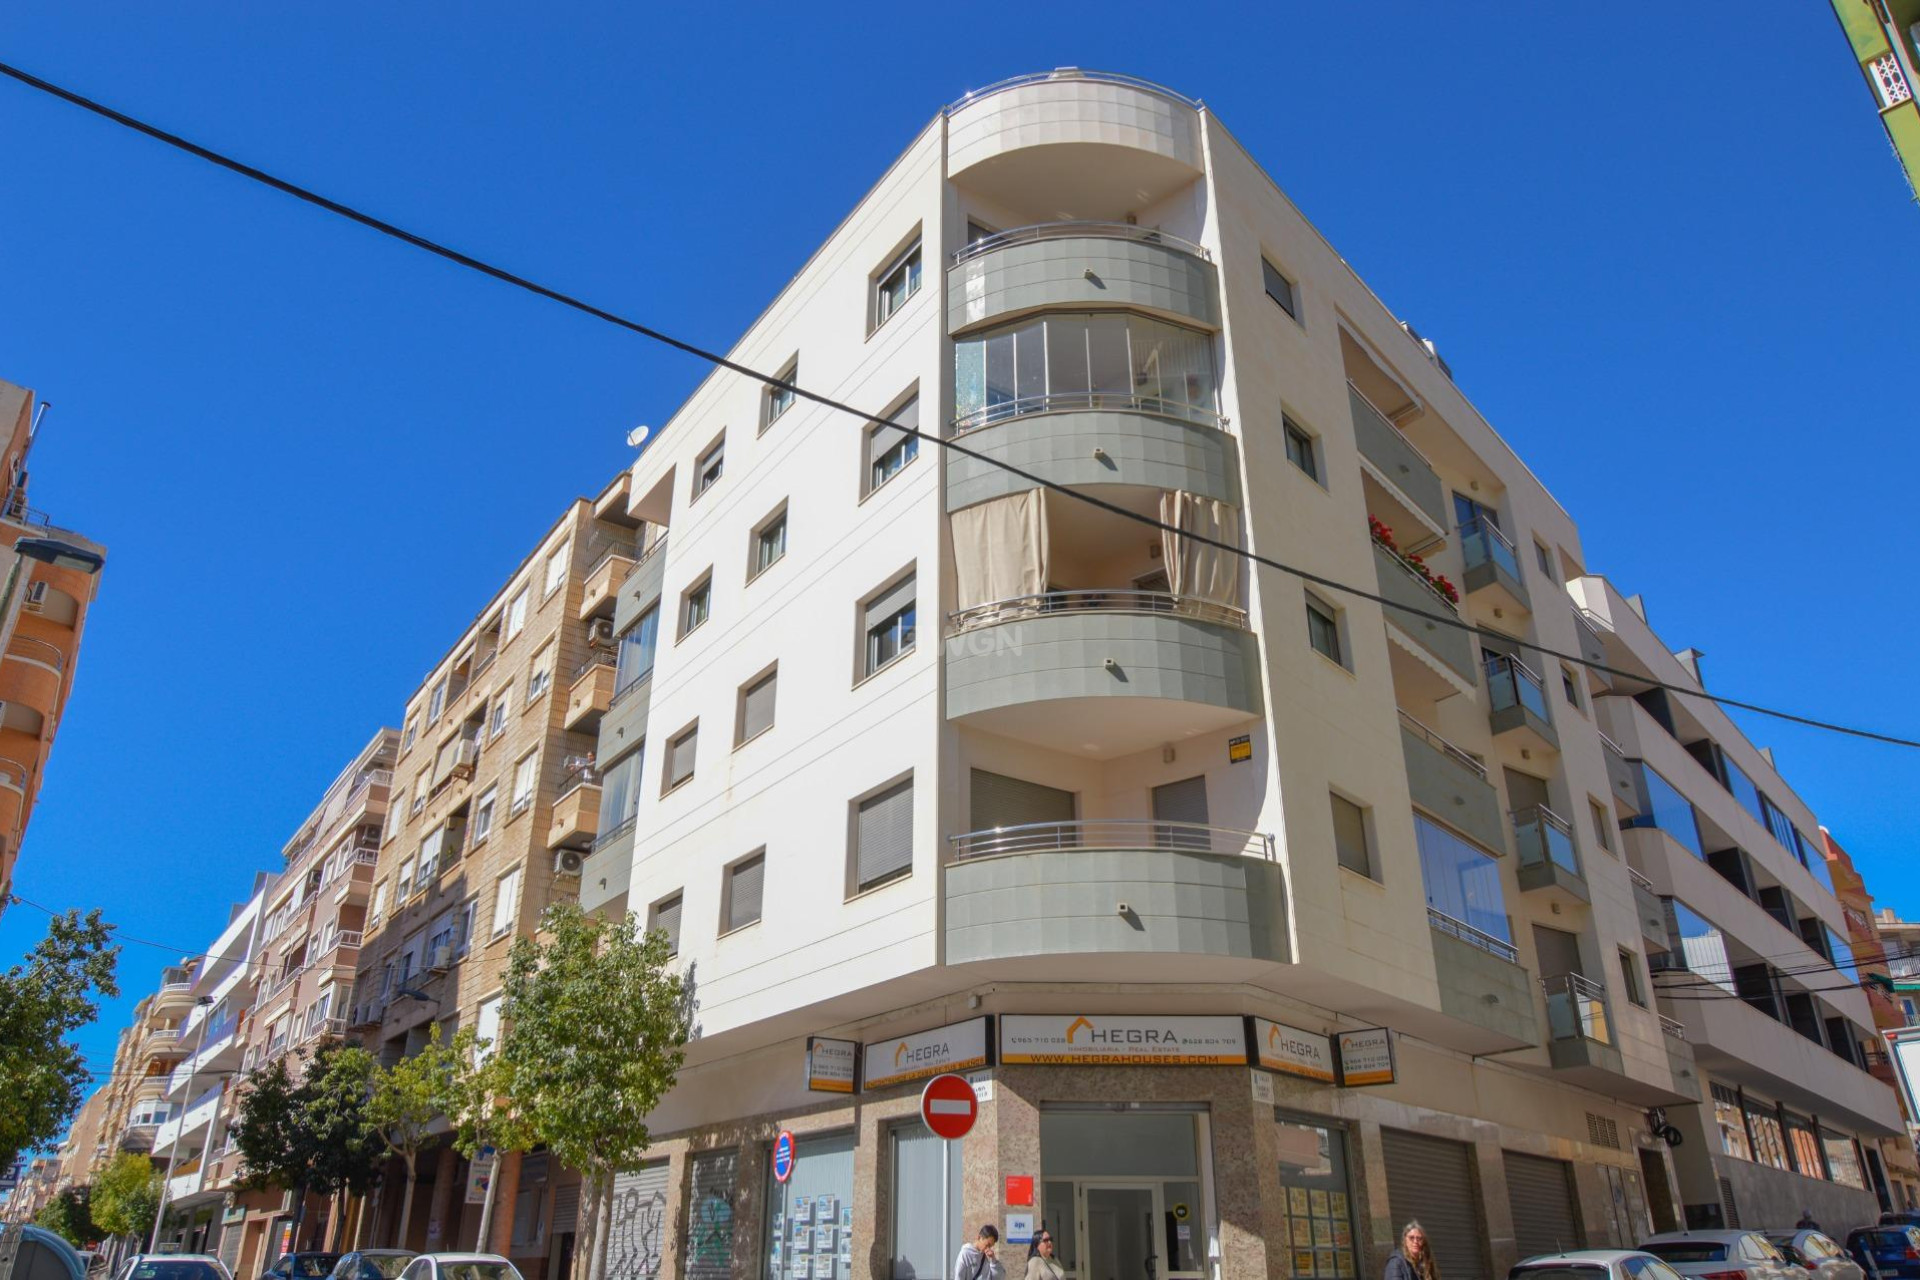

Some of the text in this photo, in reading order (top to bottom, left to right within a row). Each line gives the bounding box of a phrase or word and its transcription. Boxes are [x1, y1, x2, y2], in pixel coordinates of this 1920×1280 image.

[1091, 1029, 1178, 1043] HEGRA
[1281, 1038, 1320, 1059] HEGRA
[1351, 1039, 1385, 1048] HEGRA
[822, 1048, 852, 1056] HEGRA
[906, 1042, 950, 1063] HEGRA
[1030, 1054, 1219, 1063] WWW.HEGRAHOUSES.COM
